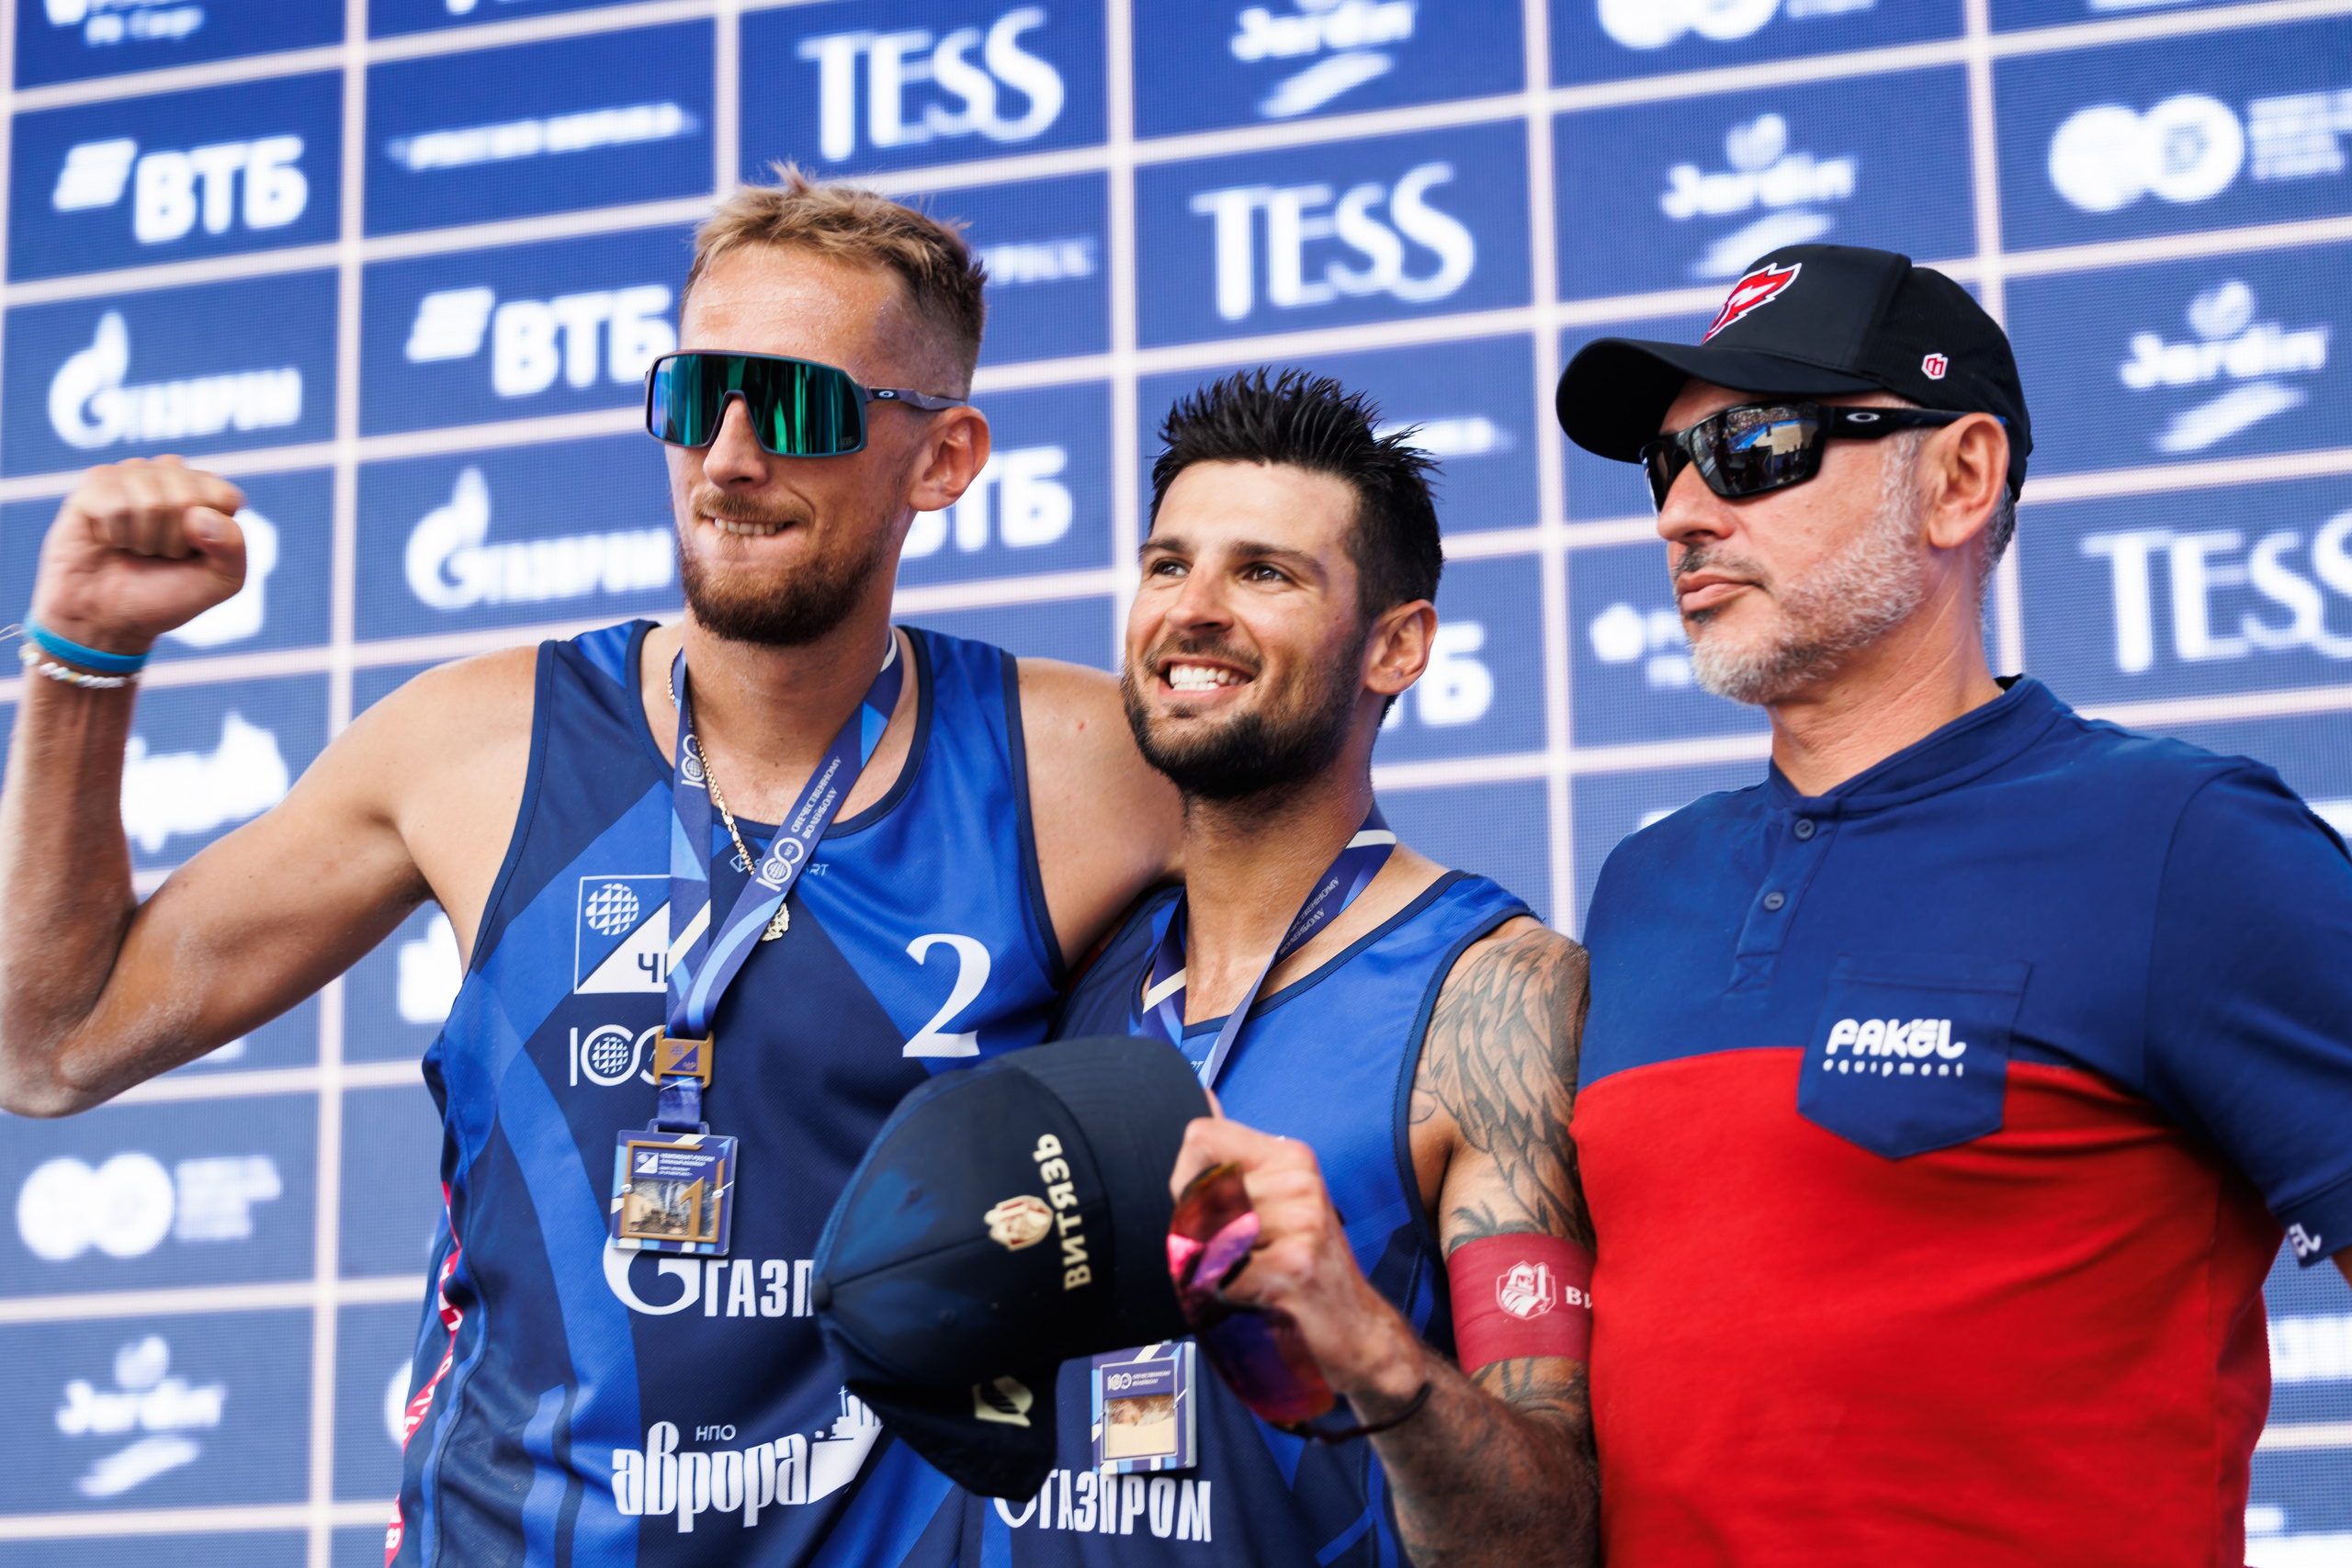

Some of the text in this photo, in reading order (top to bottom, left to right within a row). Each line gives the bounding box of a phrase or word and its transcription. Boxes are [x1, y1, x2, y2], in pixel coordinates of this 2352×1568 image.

[797, 5, 1064, 160] TESS
[134, 136, 308, 243] ВТБ
[1192, 163, 1473, 321] TESS
[492, 285, 677, 397] ВТБ
[638, 953, 668, 983] Ч
[902, 933, 991, 1058] 2
[1033, 1133, 1092, 1291] ВИТЯЗЬ
[695, 1424, 736, 1441] НПО
